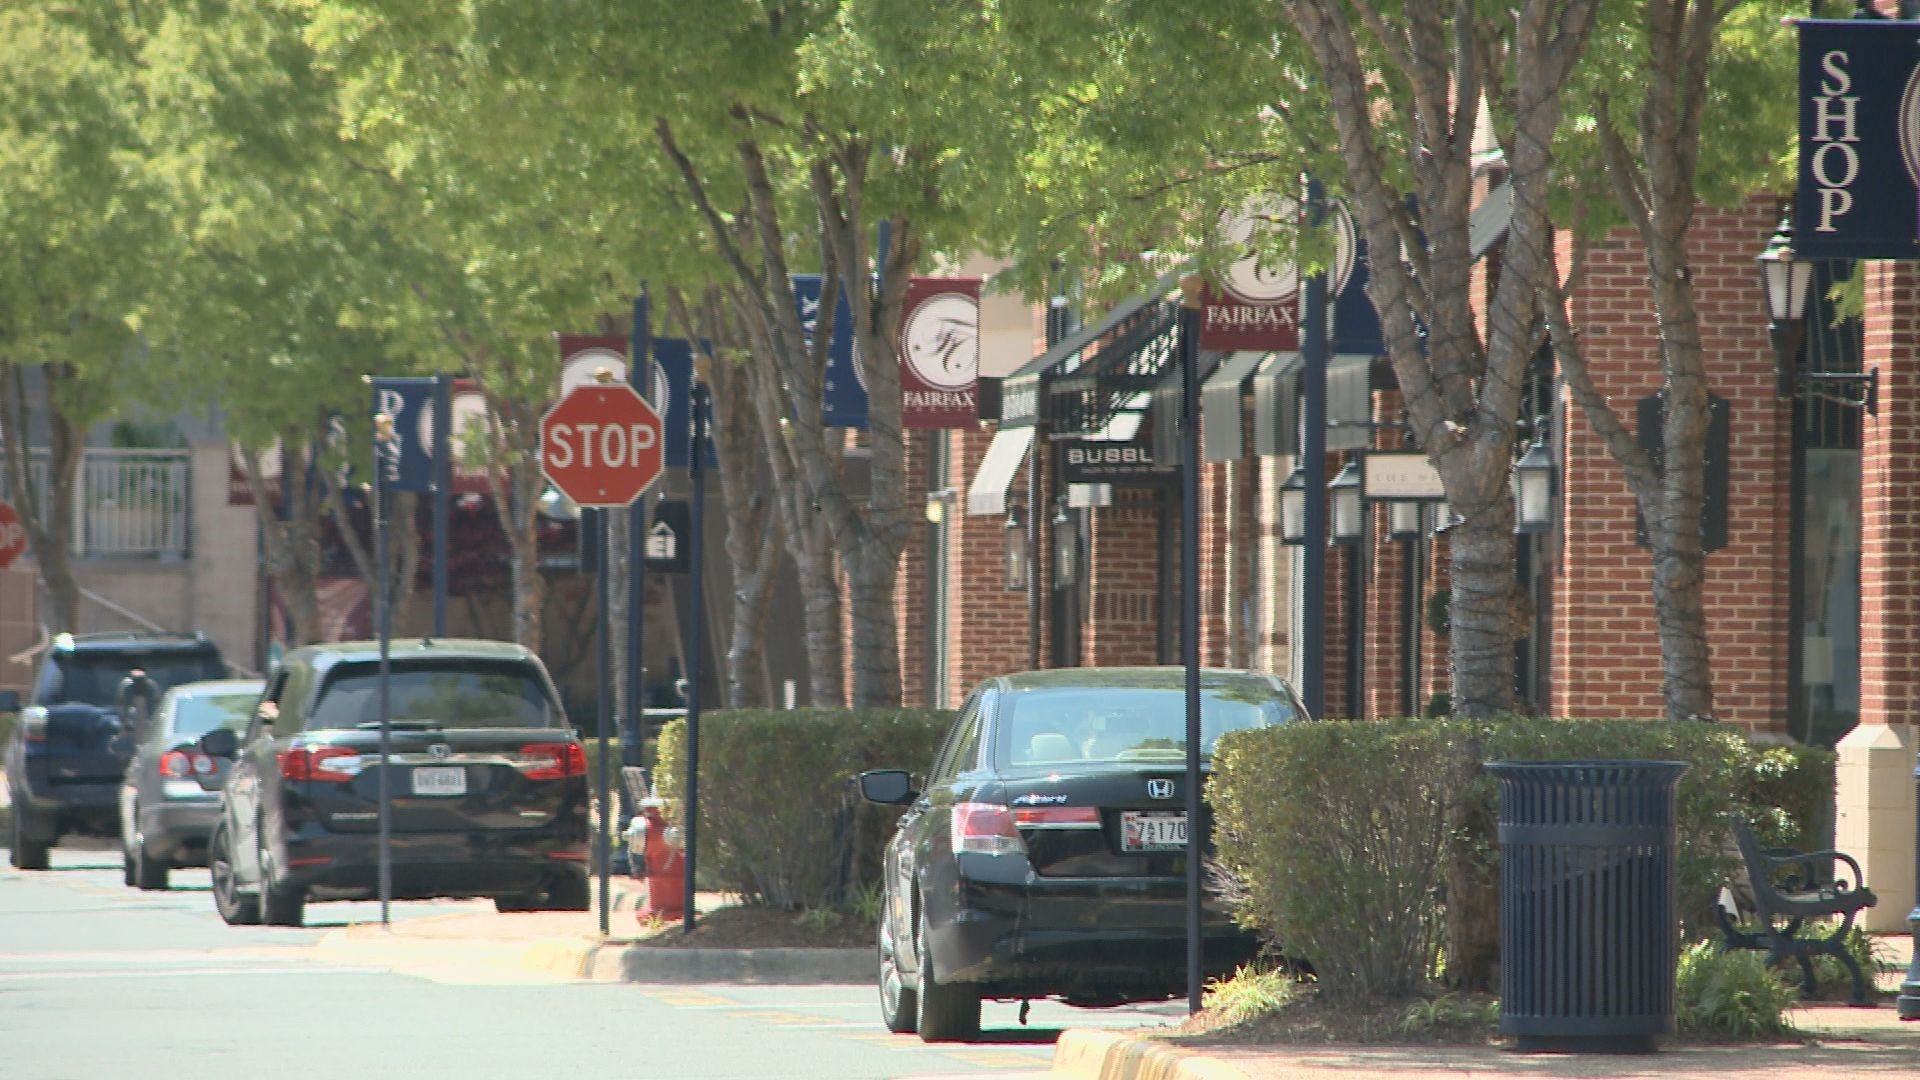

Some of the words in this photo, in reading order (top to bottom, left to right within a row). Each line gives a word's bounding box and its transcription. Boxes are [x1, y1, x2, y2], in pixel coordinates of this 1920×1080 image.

[1811, 50, 1861, 232] SHOP
[1206, 304, 1295, 325] FAIRFAX
[903, 391, 975, 409] FAIRFAX
[549, 423, 657, 469] STOP
